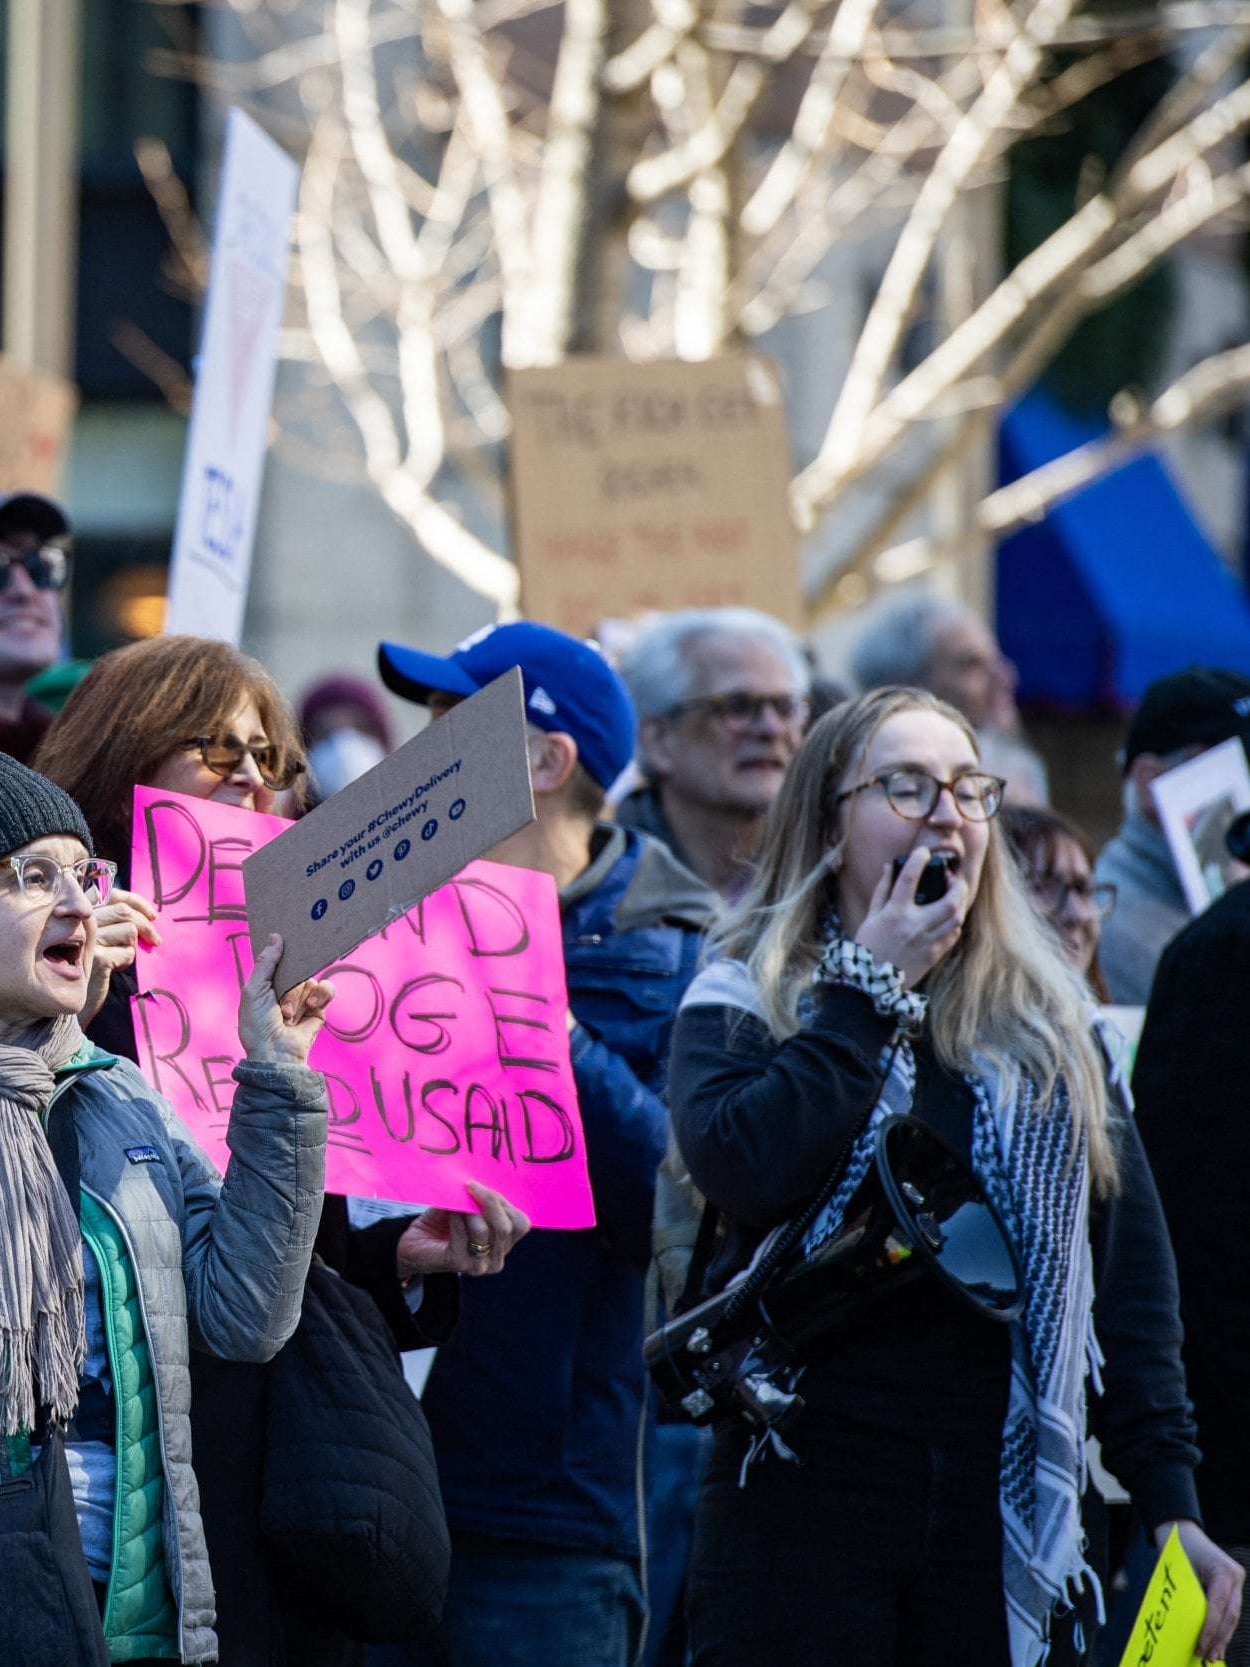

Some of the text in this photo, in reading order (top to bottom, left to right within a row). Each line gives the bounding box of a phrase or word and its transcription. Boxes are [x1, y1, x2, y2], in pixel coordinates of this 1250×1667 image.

[306, 758, 462, 877] Share your #ChewyDelivery
[340, 800, 429, 868] with us @chewy
